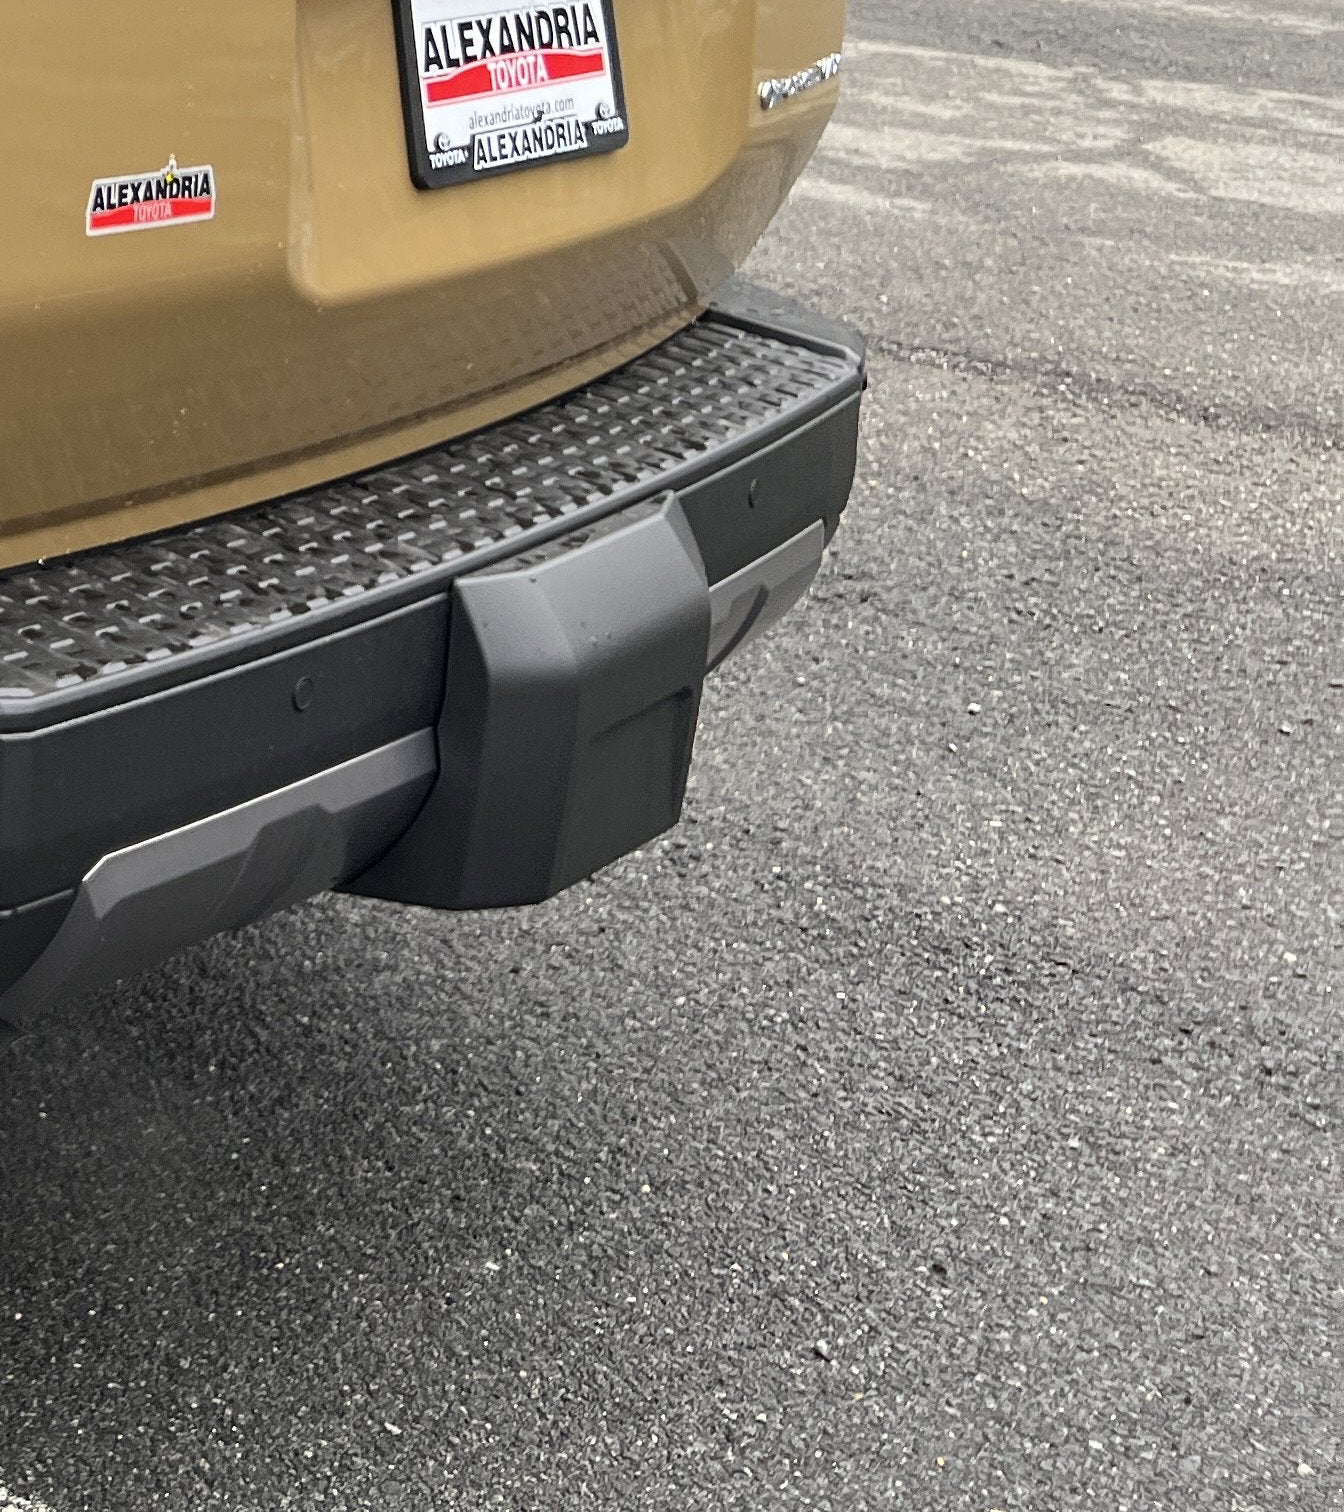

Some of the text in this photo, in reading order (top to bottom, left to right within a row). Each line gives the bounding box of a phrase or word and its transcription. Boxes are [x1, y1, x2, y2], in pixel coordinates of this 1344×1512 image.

[423, 2, 600, 73] ALEXANDRIA
[489, 54, 549, 91] TOYOTA
[468, 96, 575, 130] alexandriatoyota.com
[591, 116, 624, 135] TOYOTA
[429, 149, 465, 169] TOYOTA
[475, 120, 586, 166] ALEXANDRIA
[92, 172, 211, 212] ALEXANDRIA
[133, 200, 173, 223] TOYOTA
